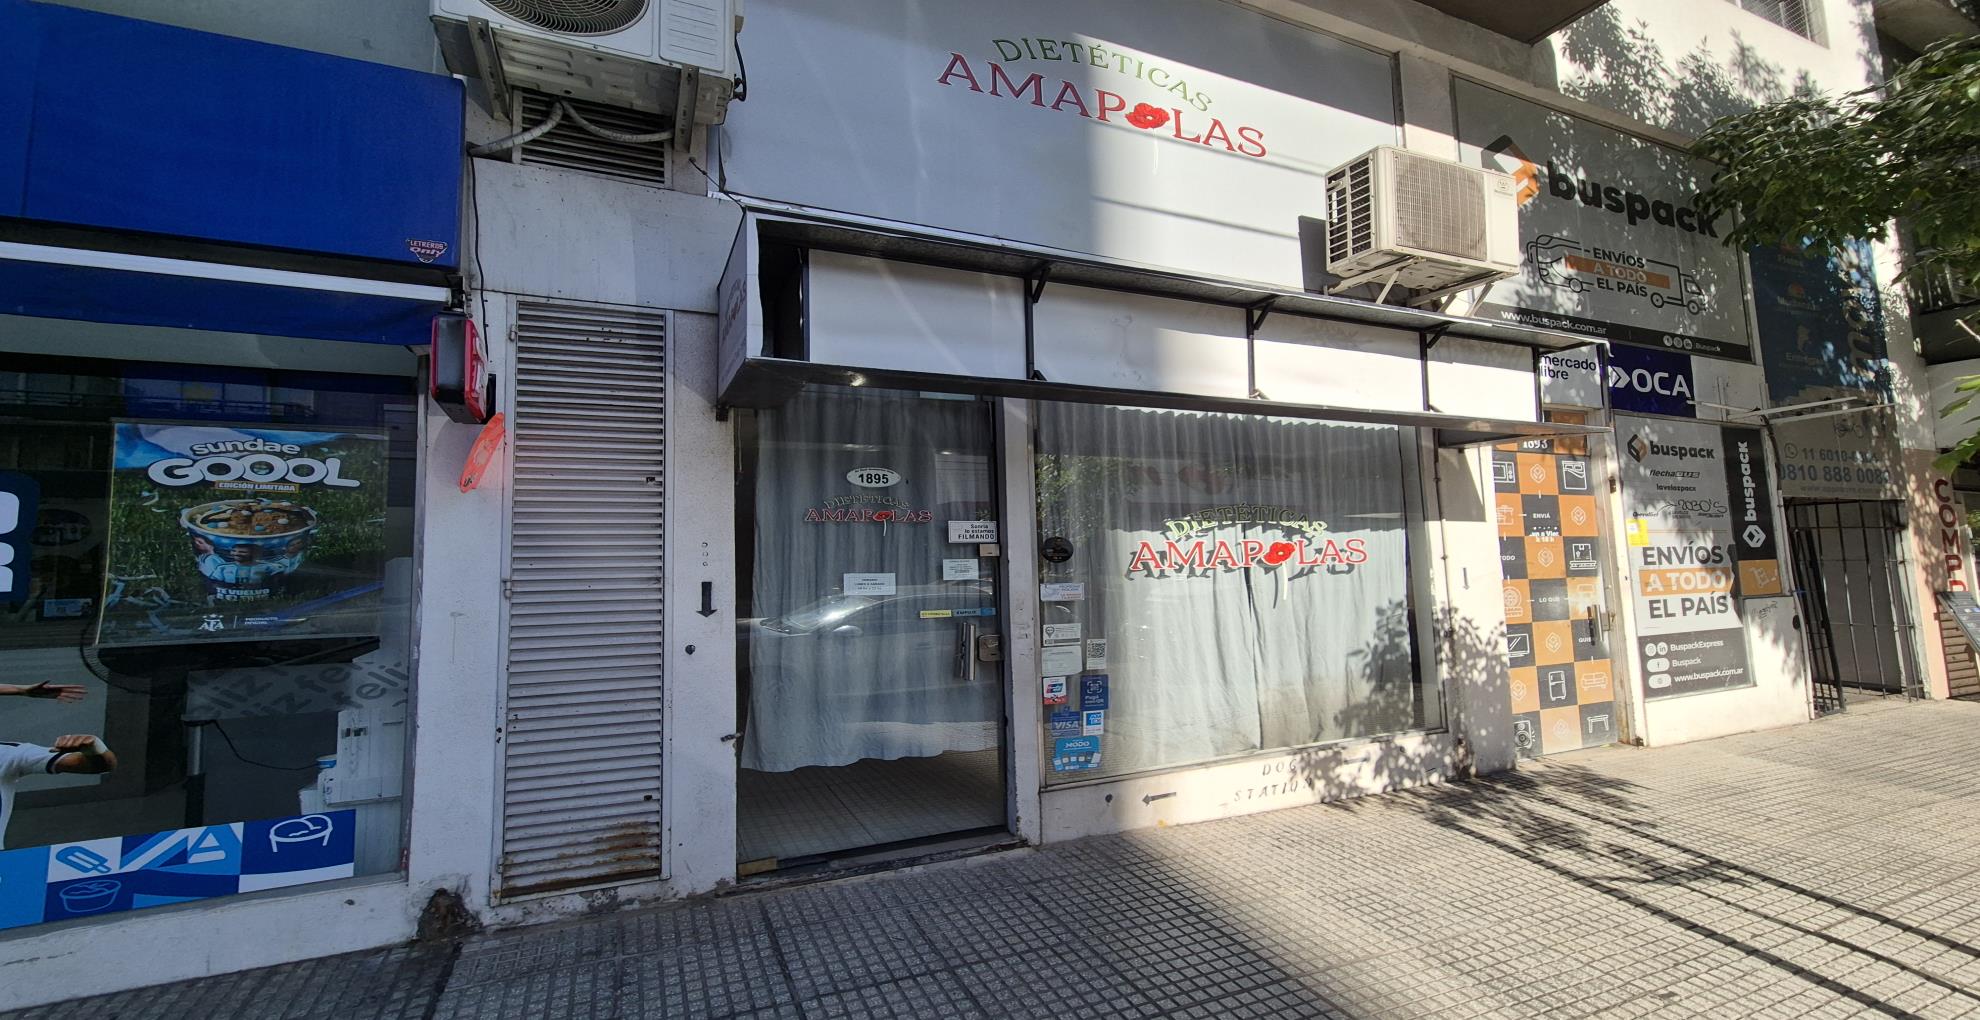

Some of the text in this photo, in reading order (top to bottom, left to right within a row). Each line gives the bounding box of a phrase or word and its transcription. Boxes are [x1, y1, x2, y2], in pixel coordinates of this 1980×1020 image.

[992, 38, 1212, 112] DIETÉTICAS
[937, 52, 1267, 158] AMAPOLAS
[1548, 160, 1719, 238] buspack
[410, 240, 444, 250] LETREROS
[1592, 246, 1645, 268] ENVÍOS
[1593, 263, 1647, 284] A TODO
[1596, 278, 1648, 297] EL PAÍS
[1501, 309, 1607, 336] www.buspack.com.ar
[1541, 353, 1597, 372] mercado
[1541, 364, 1569, 380] libre
[1631, 368, 1692, 398] OCA
[190, 438, 301, 456] sundae
[1650, 441, 1716, 460] buspack
[148, 453, 360, 487] GOOOL
[858, 473, 889, 484] 1895
[1823, 465, 1852, 483] 888
[1737, 441, 1758, 522] buspack
[805, 508, 932, 522] AMAPOLAS
[1165, 502, 1328, 538] DIETÉTICAS
[1131, 538, 1368, 570] AMAPOLAS
[1642, 541, 1725, 566] ENVÍOS
[1647, 573, 1664, 593] A
[1666, 570, 1727, 592] TODO
[1648, 598, 1676, 619] EL
[1681, 591, 1730, 617] PAÍS
[1670, 640, 1724, 652] BuspackExpress
[1672, 657, 1702, 668] Buspack
[1674, 667, 1744, 683] www.buspack.com.ar
[1054, 721, 1080, 729] VISA
